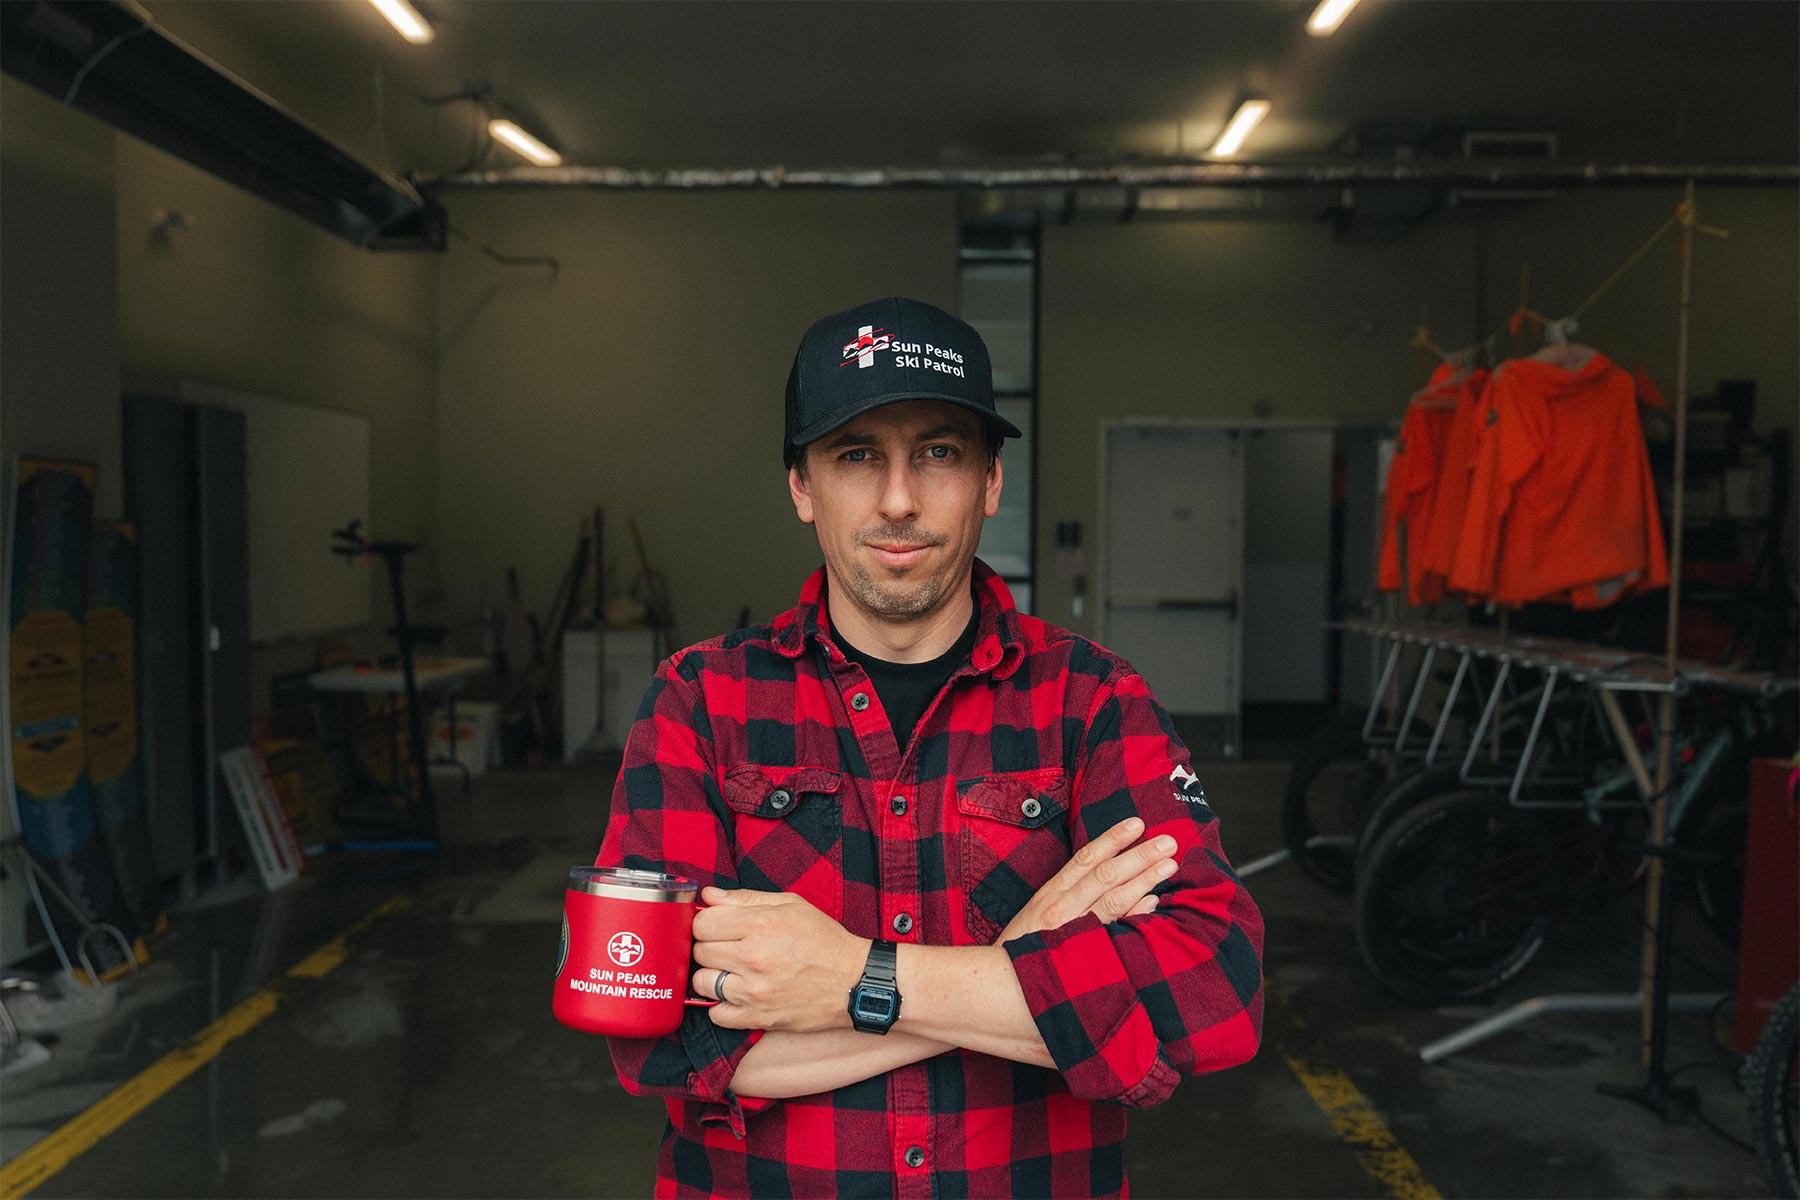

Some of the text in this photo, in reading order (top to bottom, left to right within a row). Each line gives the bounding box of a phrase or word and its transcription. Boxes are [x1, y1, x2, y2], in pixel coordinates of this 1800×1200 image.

[891, 341, 963, 364] Sun Peaks
[896, 355, 965, 378] Ski Patrol
[1190, 796, 1210, 808] PEA
[589, 968, 657, 985] SUN PEAKS
[570, 978, 673, 999] MOUNTAIN RESCUE
